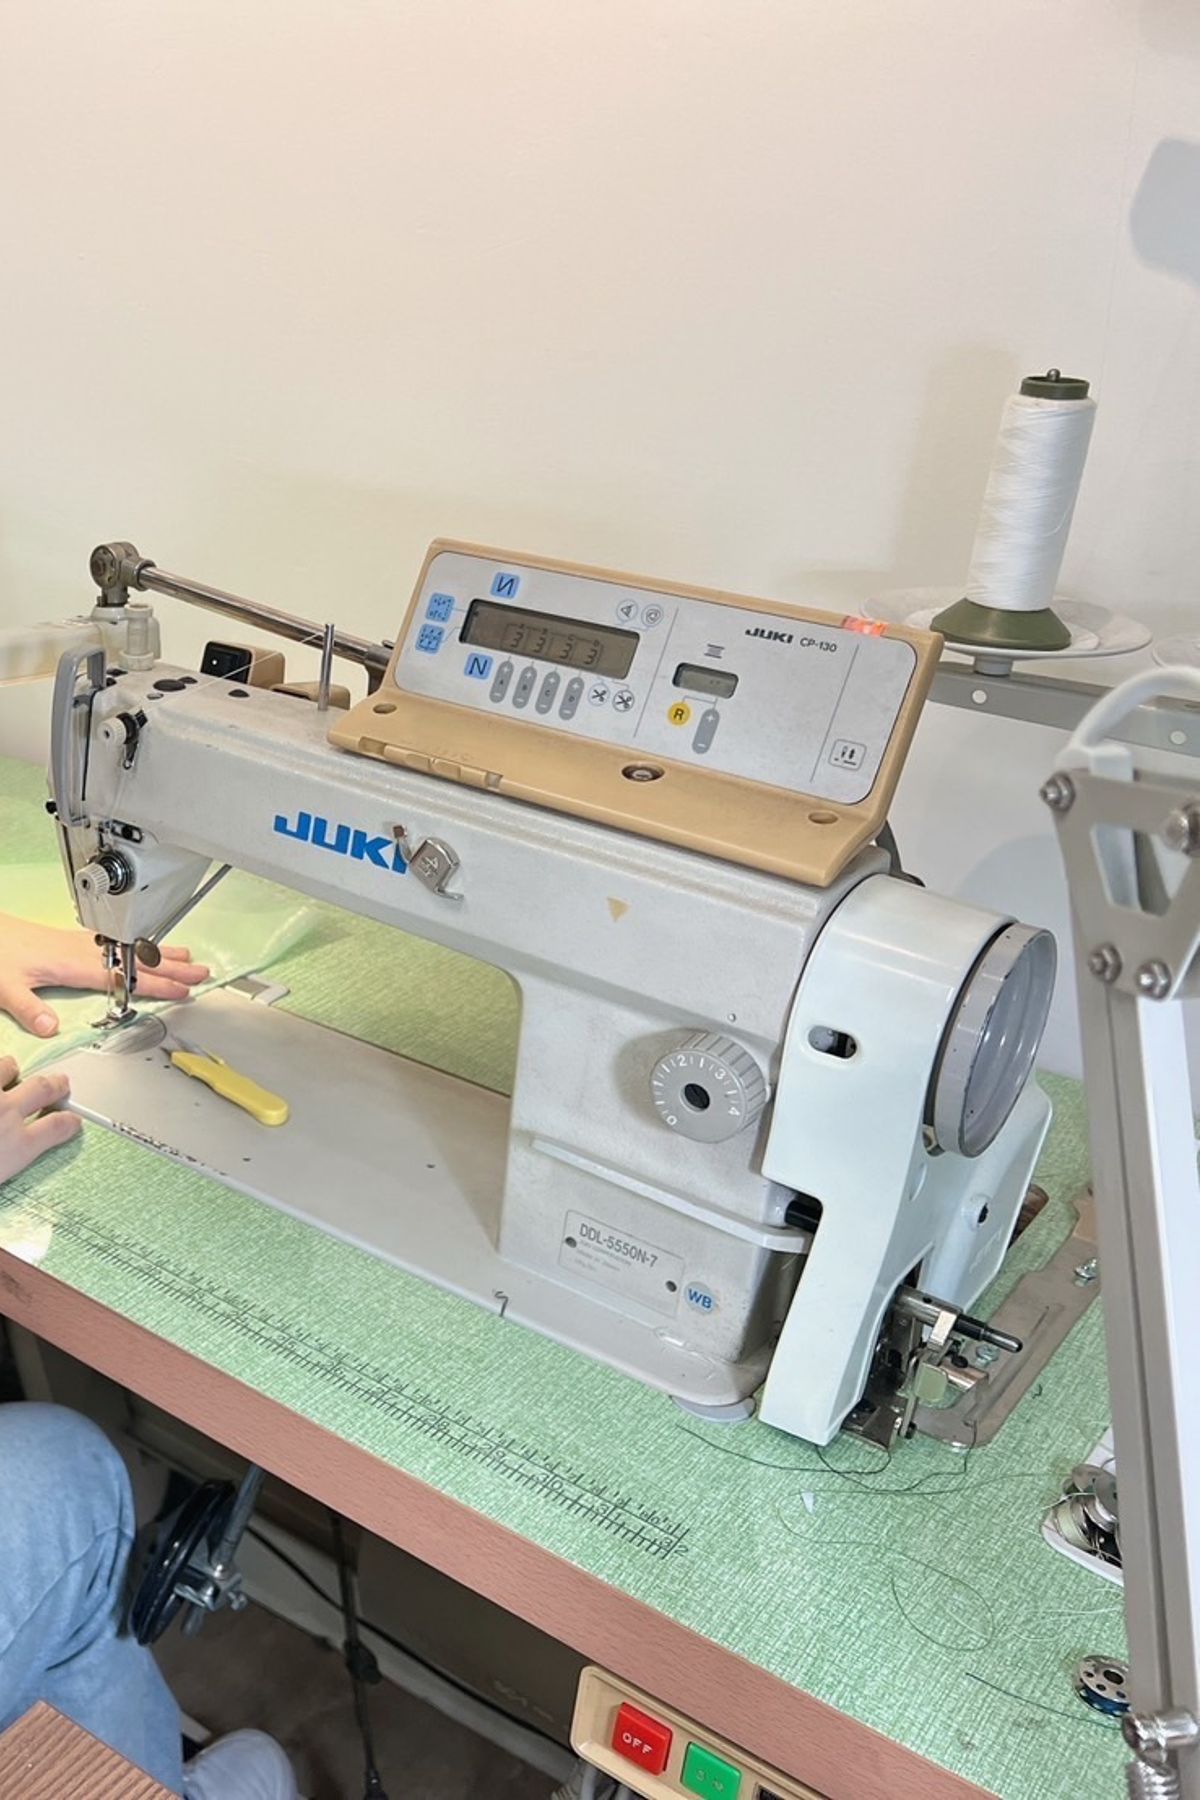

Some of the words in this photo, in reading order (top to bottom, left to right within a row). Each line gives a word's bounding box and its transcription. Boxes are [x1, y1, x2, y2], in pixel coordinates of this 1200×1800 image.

[744, 627, 794, 645] JUKI
[799, 637, 838, 653] CP-130
[673, 708, 685, 721] R
[273, 811, 408, 875] JUKI
[676, 1054, 688, 1067] 2
[714, 1068, 726, 1080] 3
[728, 1106, 741, 1116] 4
[579, 1223, 659, 1268] DDL-5550N-7
[687, 1287, 713, 1310] WB
[534, 1472, 564, 1491] 30
[659, 1536, 689, 1557] 32
[621, 1732, 653, 1755] OFF
